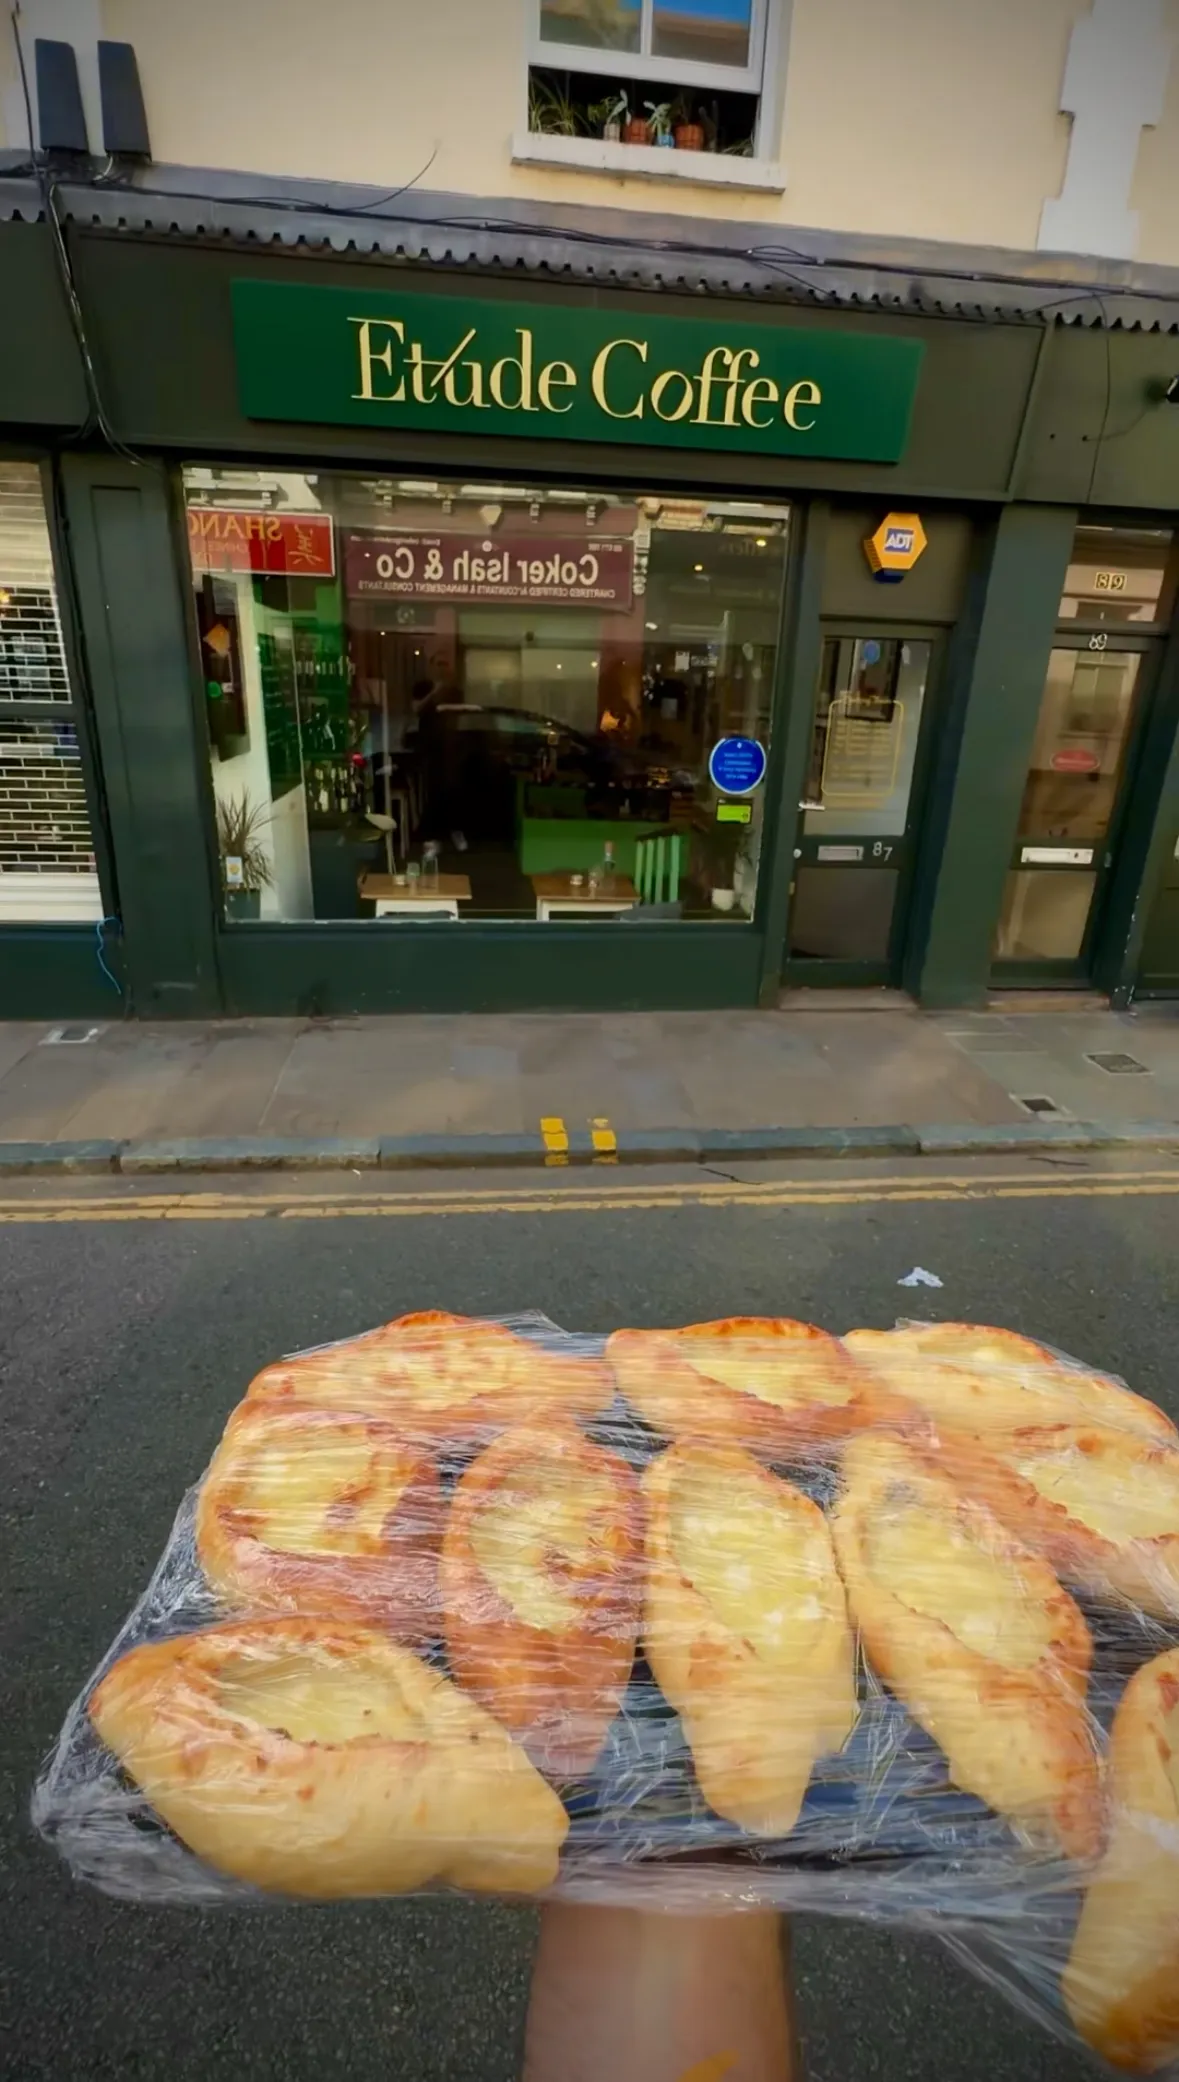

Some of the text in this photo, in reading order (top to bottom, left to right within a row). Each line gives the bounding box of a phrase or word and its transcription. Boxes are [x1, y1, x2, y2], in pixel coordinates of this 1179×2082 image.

[591, 338, 821, 431] Coffee
[886, 532, 915, 549] ADT
[1096, 573, 1125, 590] 89
[872, 841, 893, 862] 87
